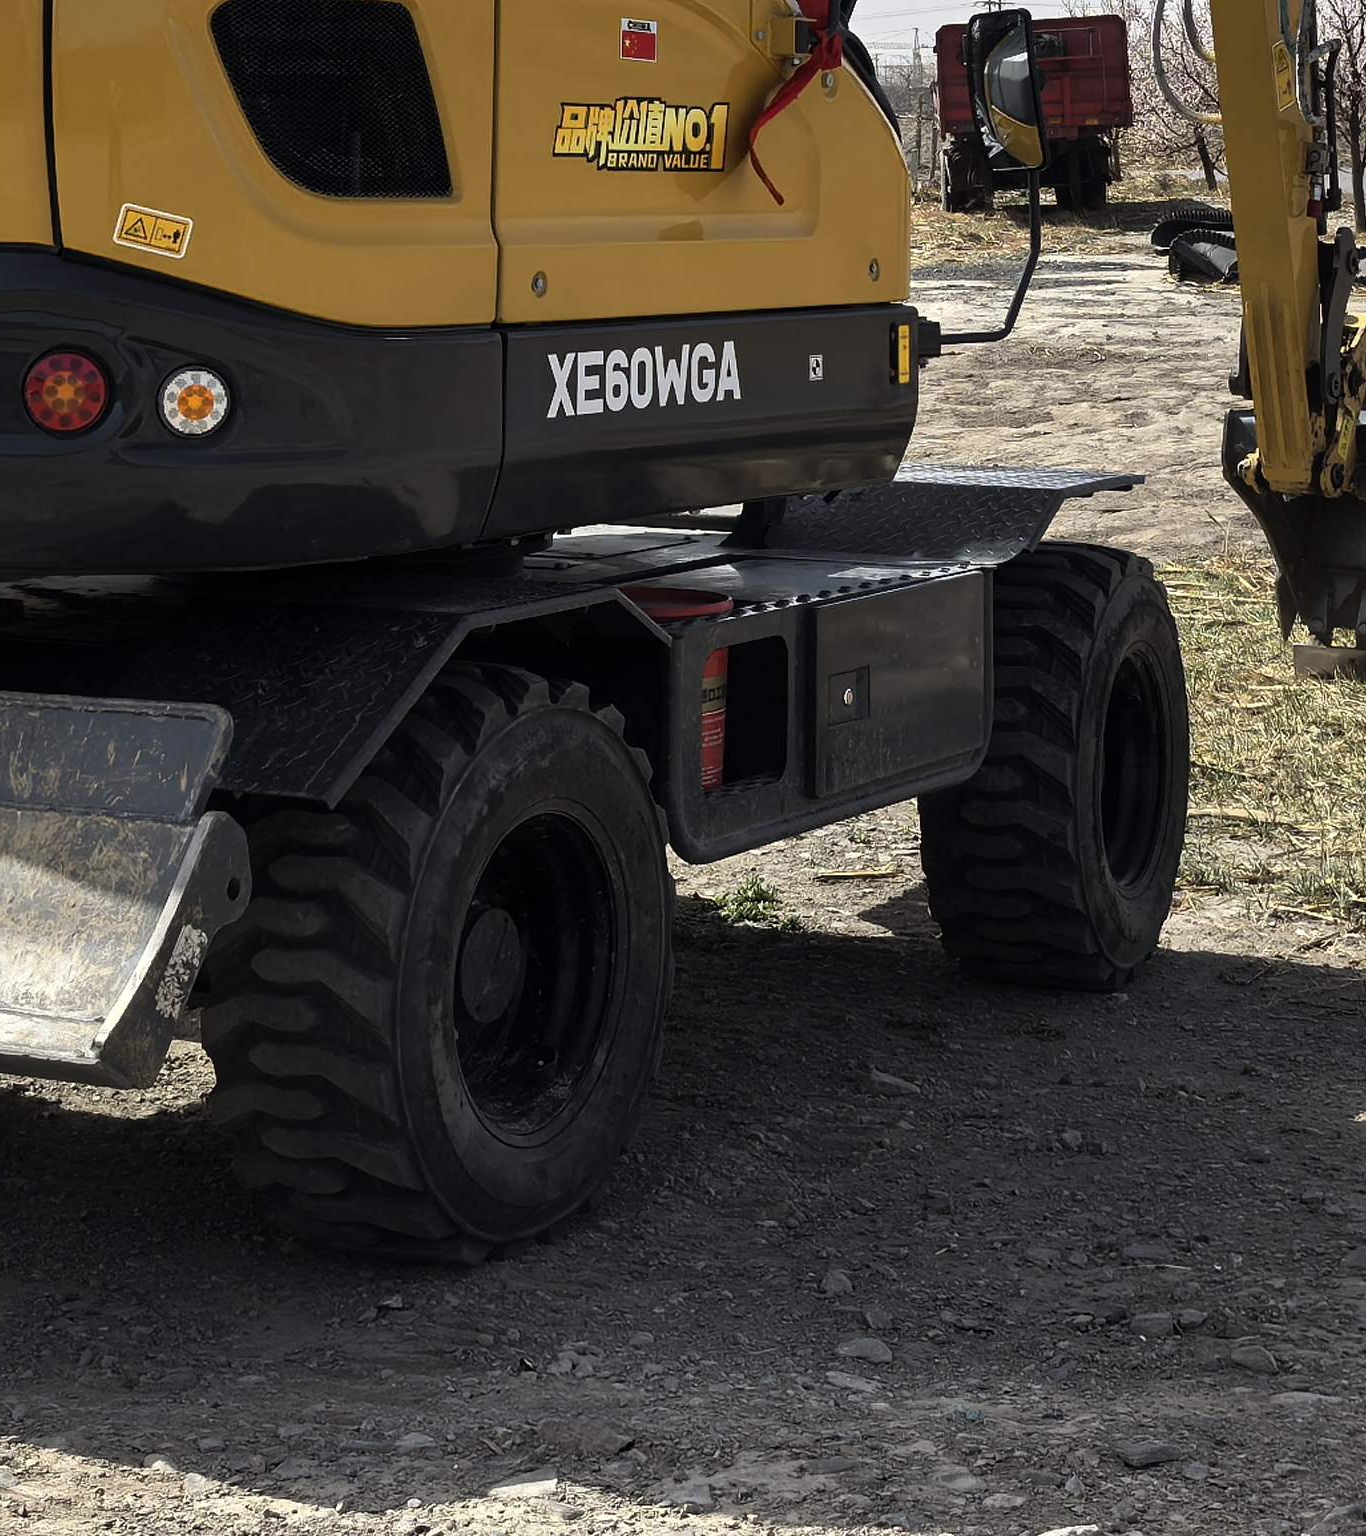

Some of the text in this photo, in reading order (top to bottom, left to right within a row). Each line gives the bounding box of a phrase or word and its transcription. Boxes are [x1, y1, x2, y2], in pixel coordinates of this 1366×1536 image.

[607, 153, 708, 168] BRAND VALUE
[547, 340, 741, 418] XE60WGA
